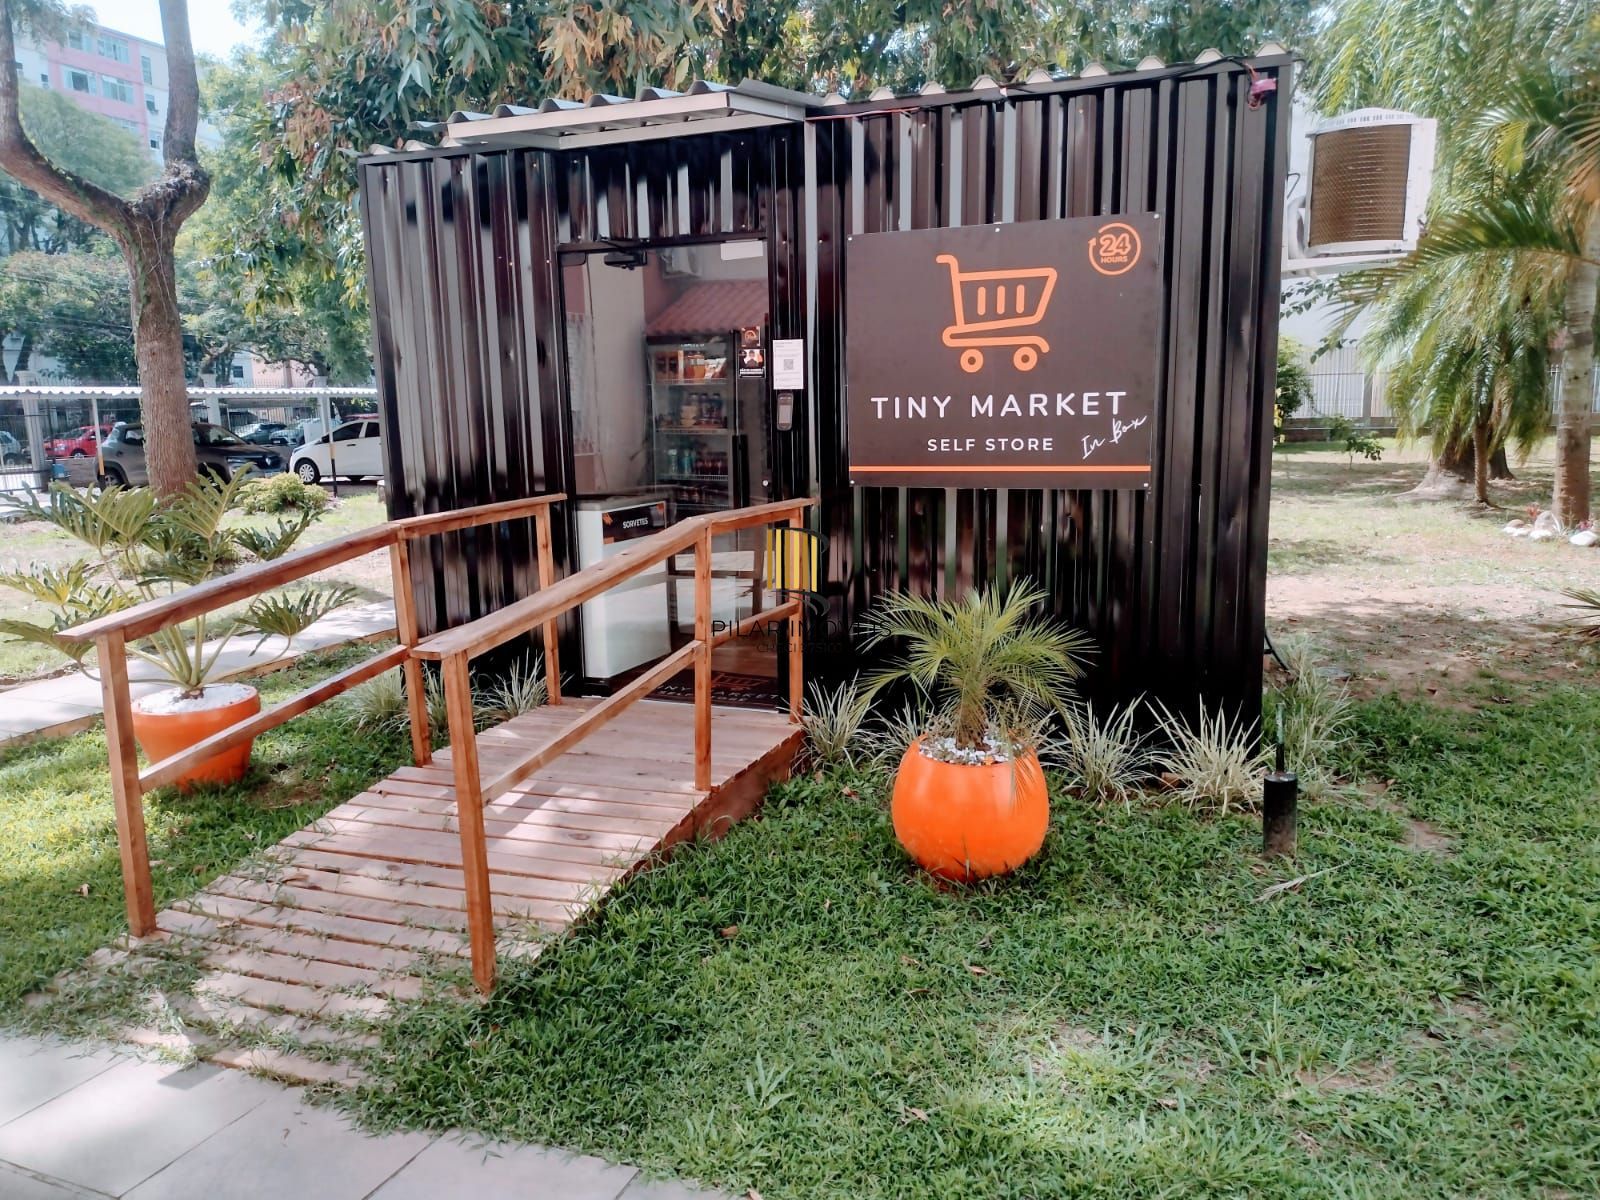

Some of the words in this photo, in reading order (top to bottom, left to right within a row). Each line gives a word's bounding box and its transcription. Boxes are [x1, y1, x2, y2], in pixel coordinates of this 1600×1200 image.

[1099, 232, 1132, 256] 24
[1100, 255, 1128, 264] HOURS
[870, 395, 952, 419] TINY
[971, 391, 1128, 418] MARKET
[927, 438, 977, 452] SELF
[985, 437, 1054, 452] STORE
[622, 517, 649, 529] SORVETES
